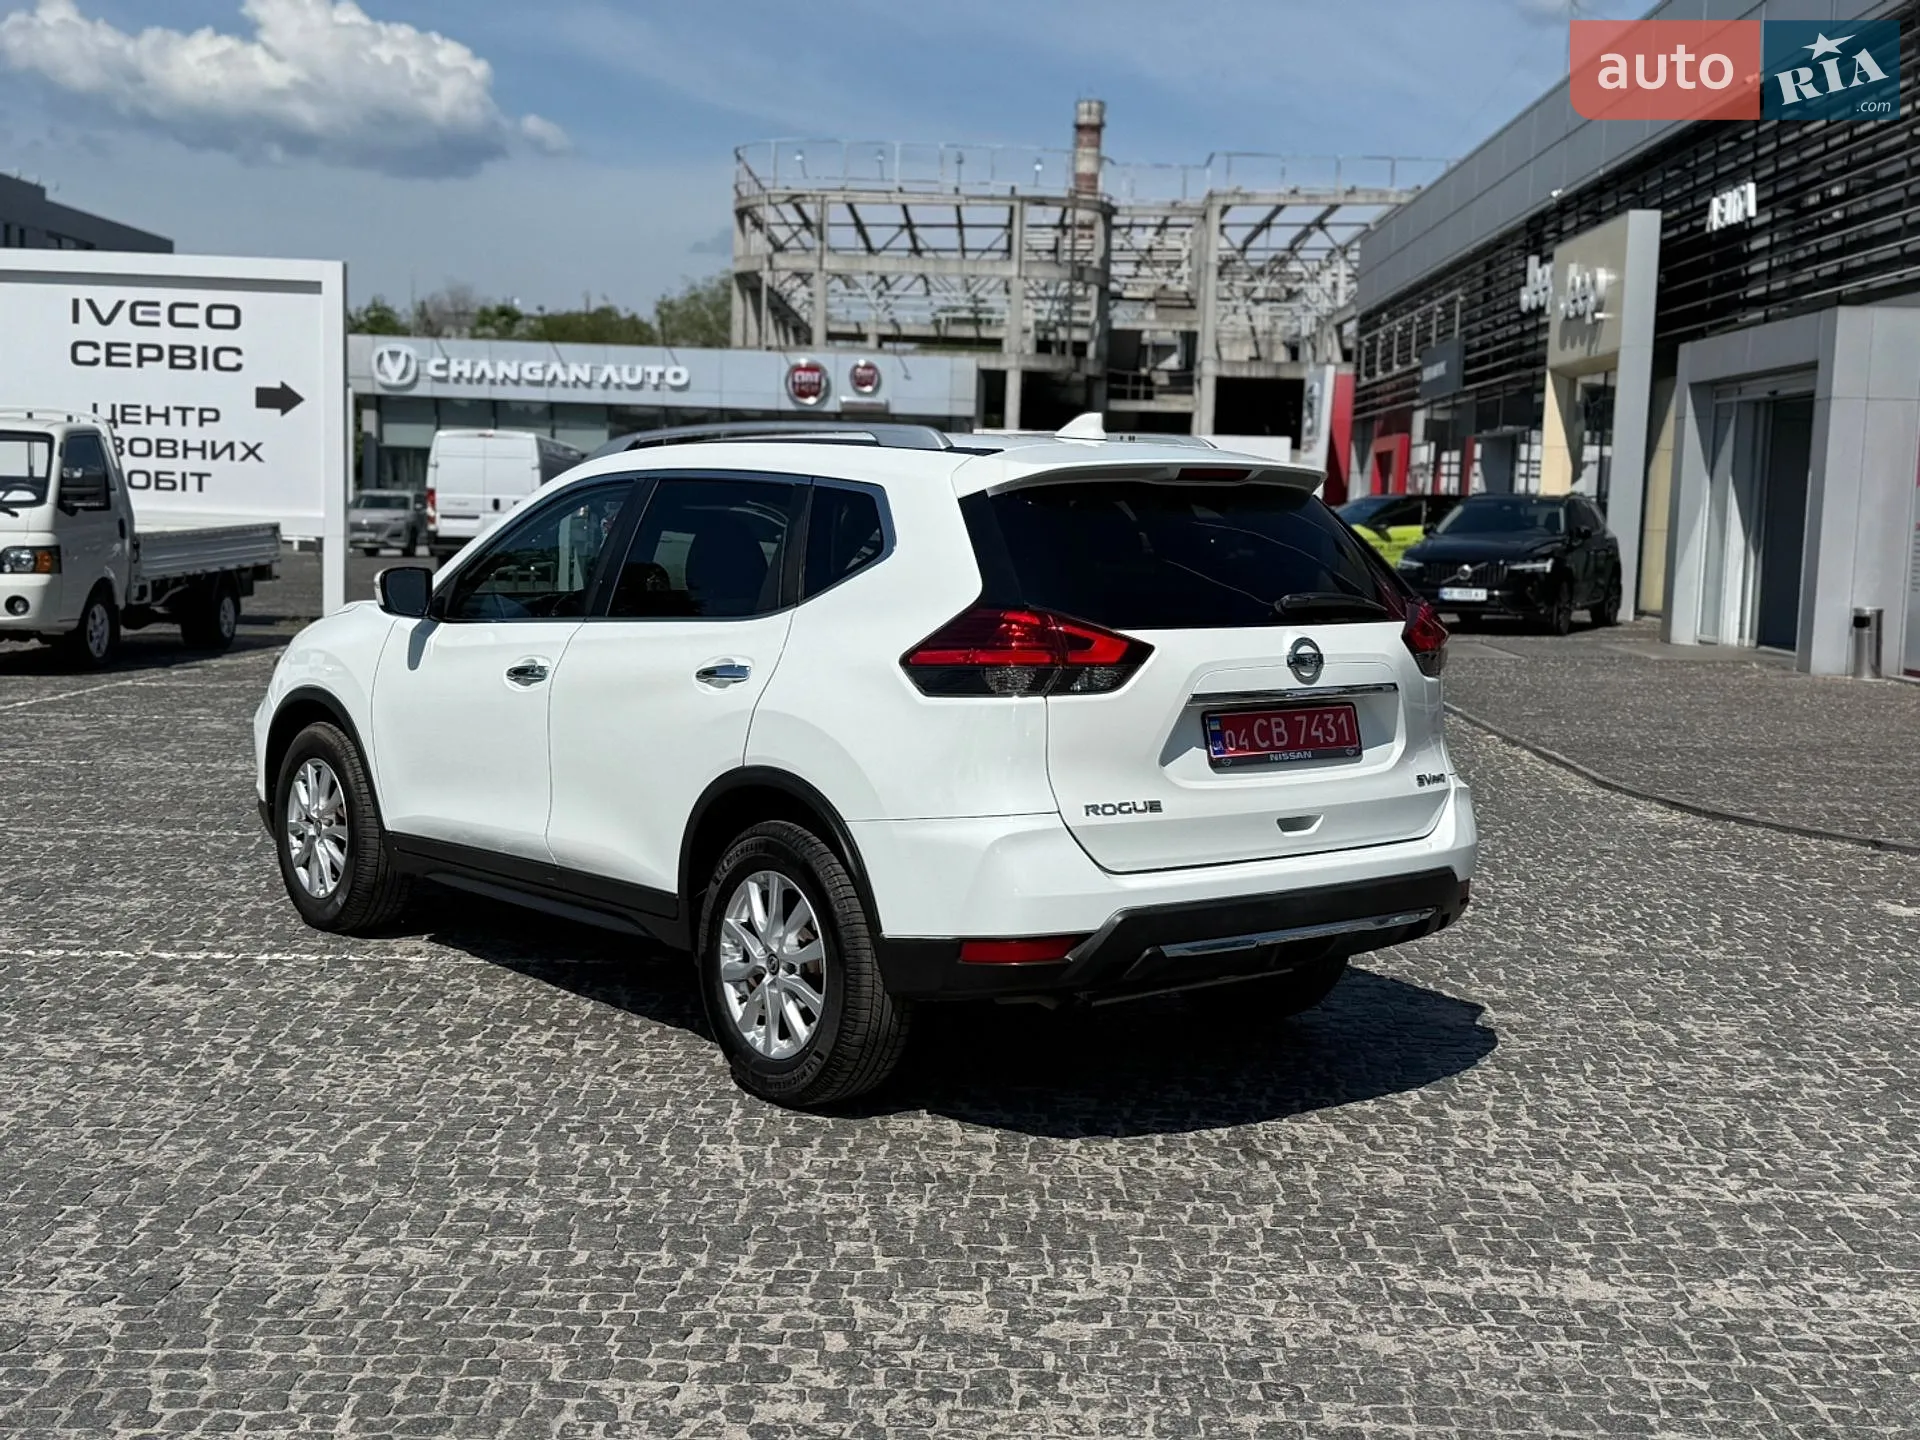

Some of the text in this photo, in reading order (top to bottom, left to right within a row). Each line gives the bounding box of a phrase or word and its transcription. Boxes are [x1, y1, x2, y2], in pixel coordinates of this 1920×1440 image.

[72, 297, 242, 331] IVECO
[70, 340, 244, 372] СЕРВІС
[427, 357, 691, 386] CHANGAN AUTO
[92, 402, 221, 429] ЦЕНТР
[113, 436, 265, 463] ЗОВНИХ
[127, 469, 212, 493] ОБІТ
[1224, 712, 1351, 751] 04 CB 7431
[1269, 750, 1313, 762] NISSAN
[1083, 799, 1163, 817] ROGUE
